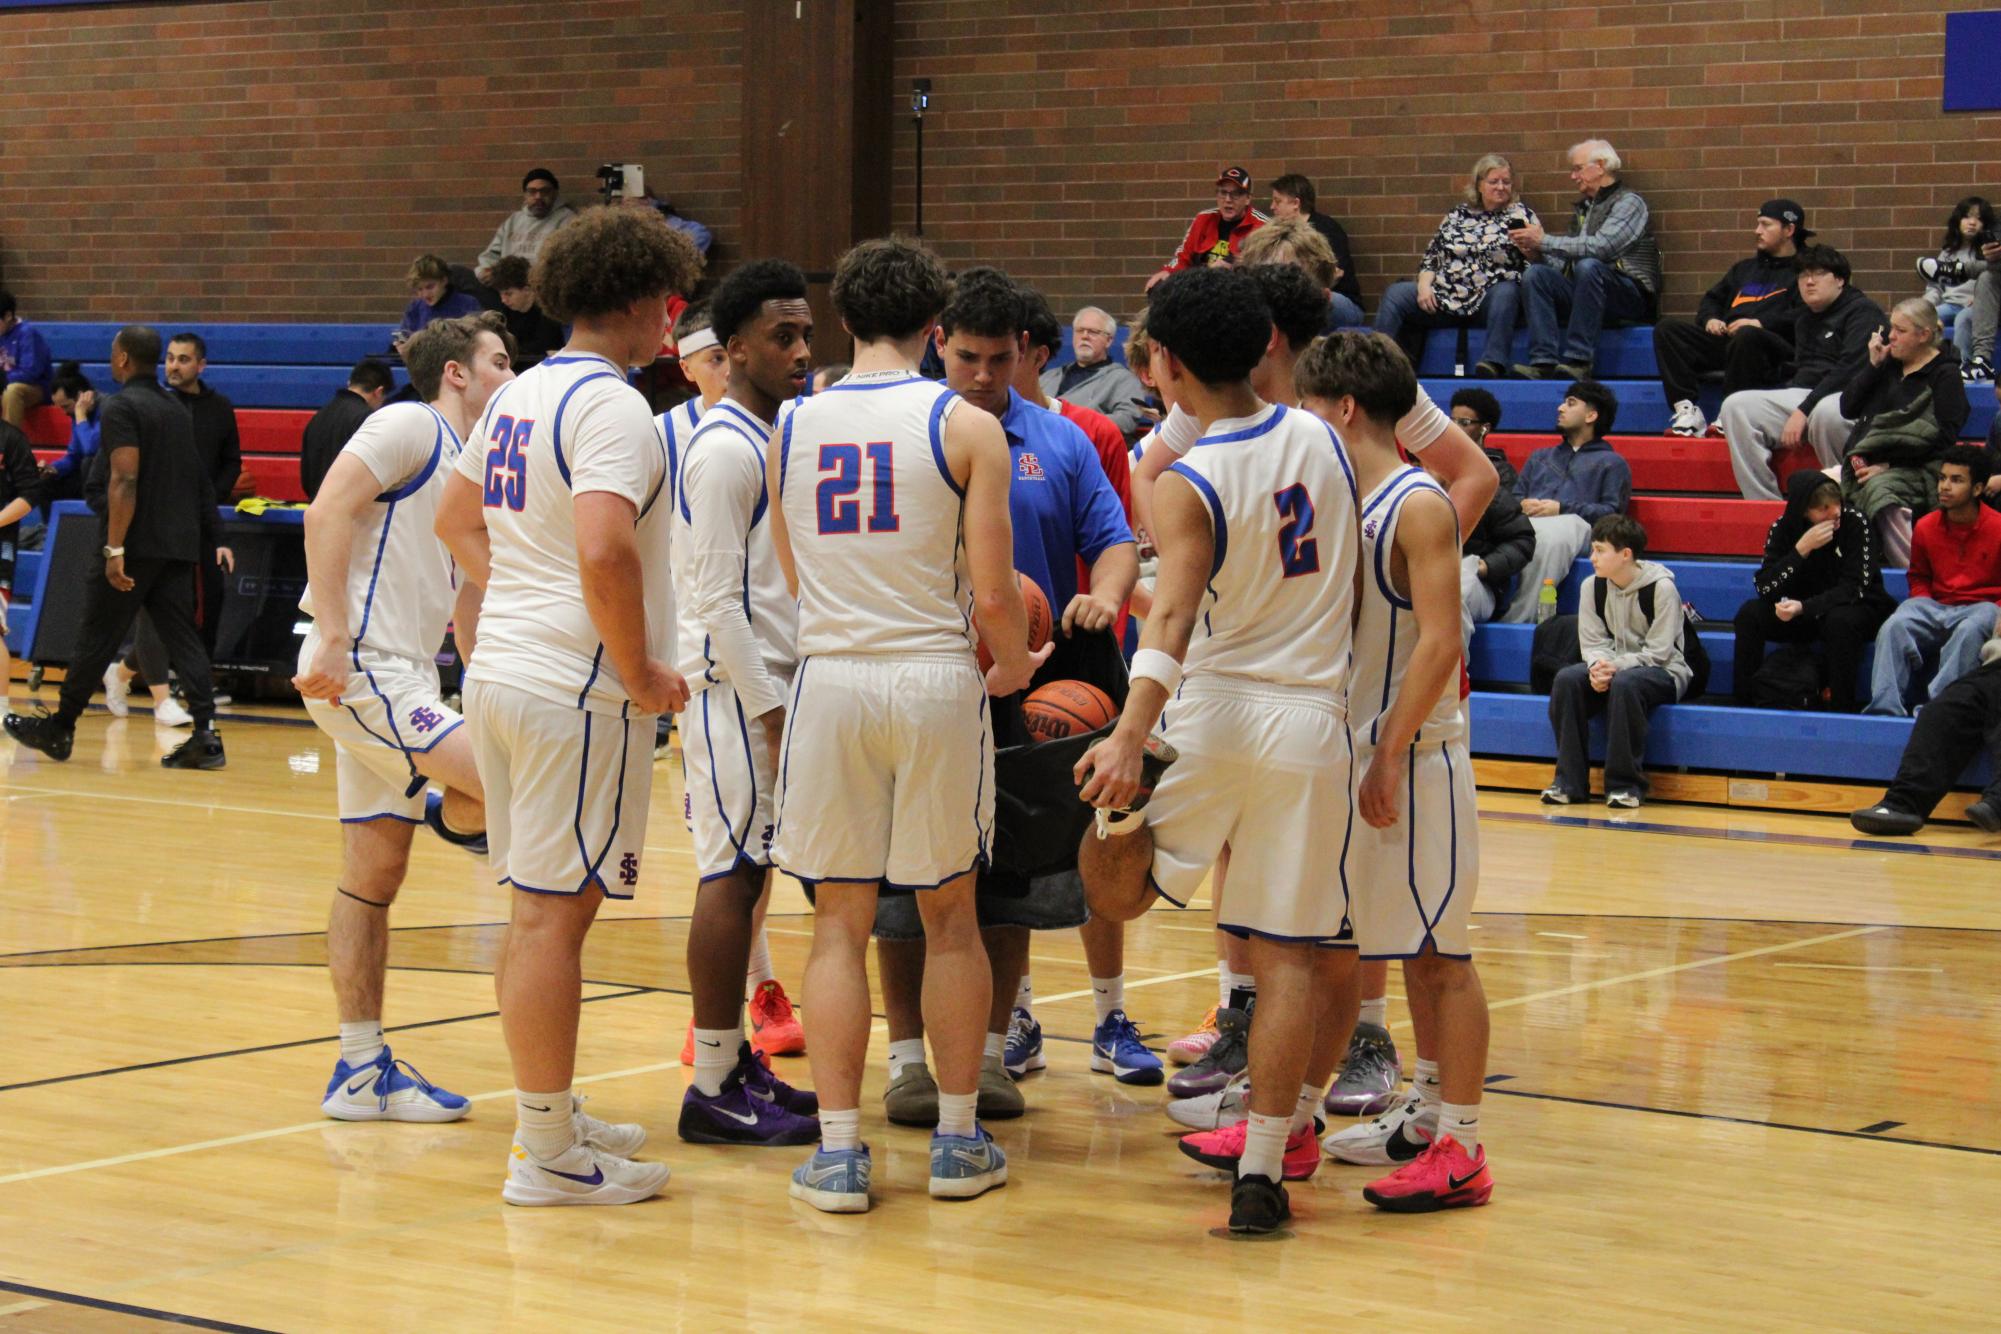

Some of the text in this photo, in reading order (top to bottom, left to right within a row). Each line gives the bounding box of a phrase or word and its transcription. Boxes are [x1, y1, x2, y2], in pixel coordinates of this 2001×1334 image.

[857, 371, 879, 379] NIKE
[484, 414, 535, 512] 25
[816, 441, 900, 535] 21
[1273, 482, 1320, 578] 2
